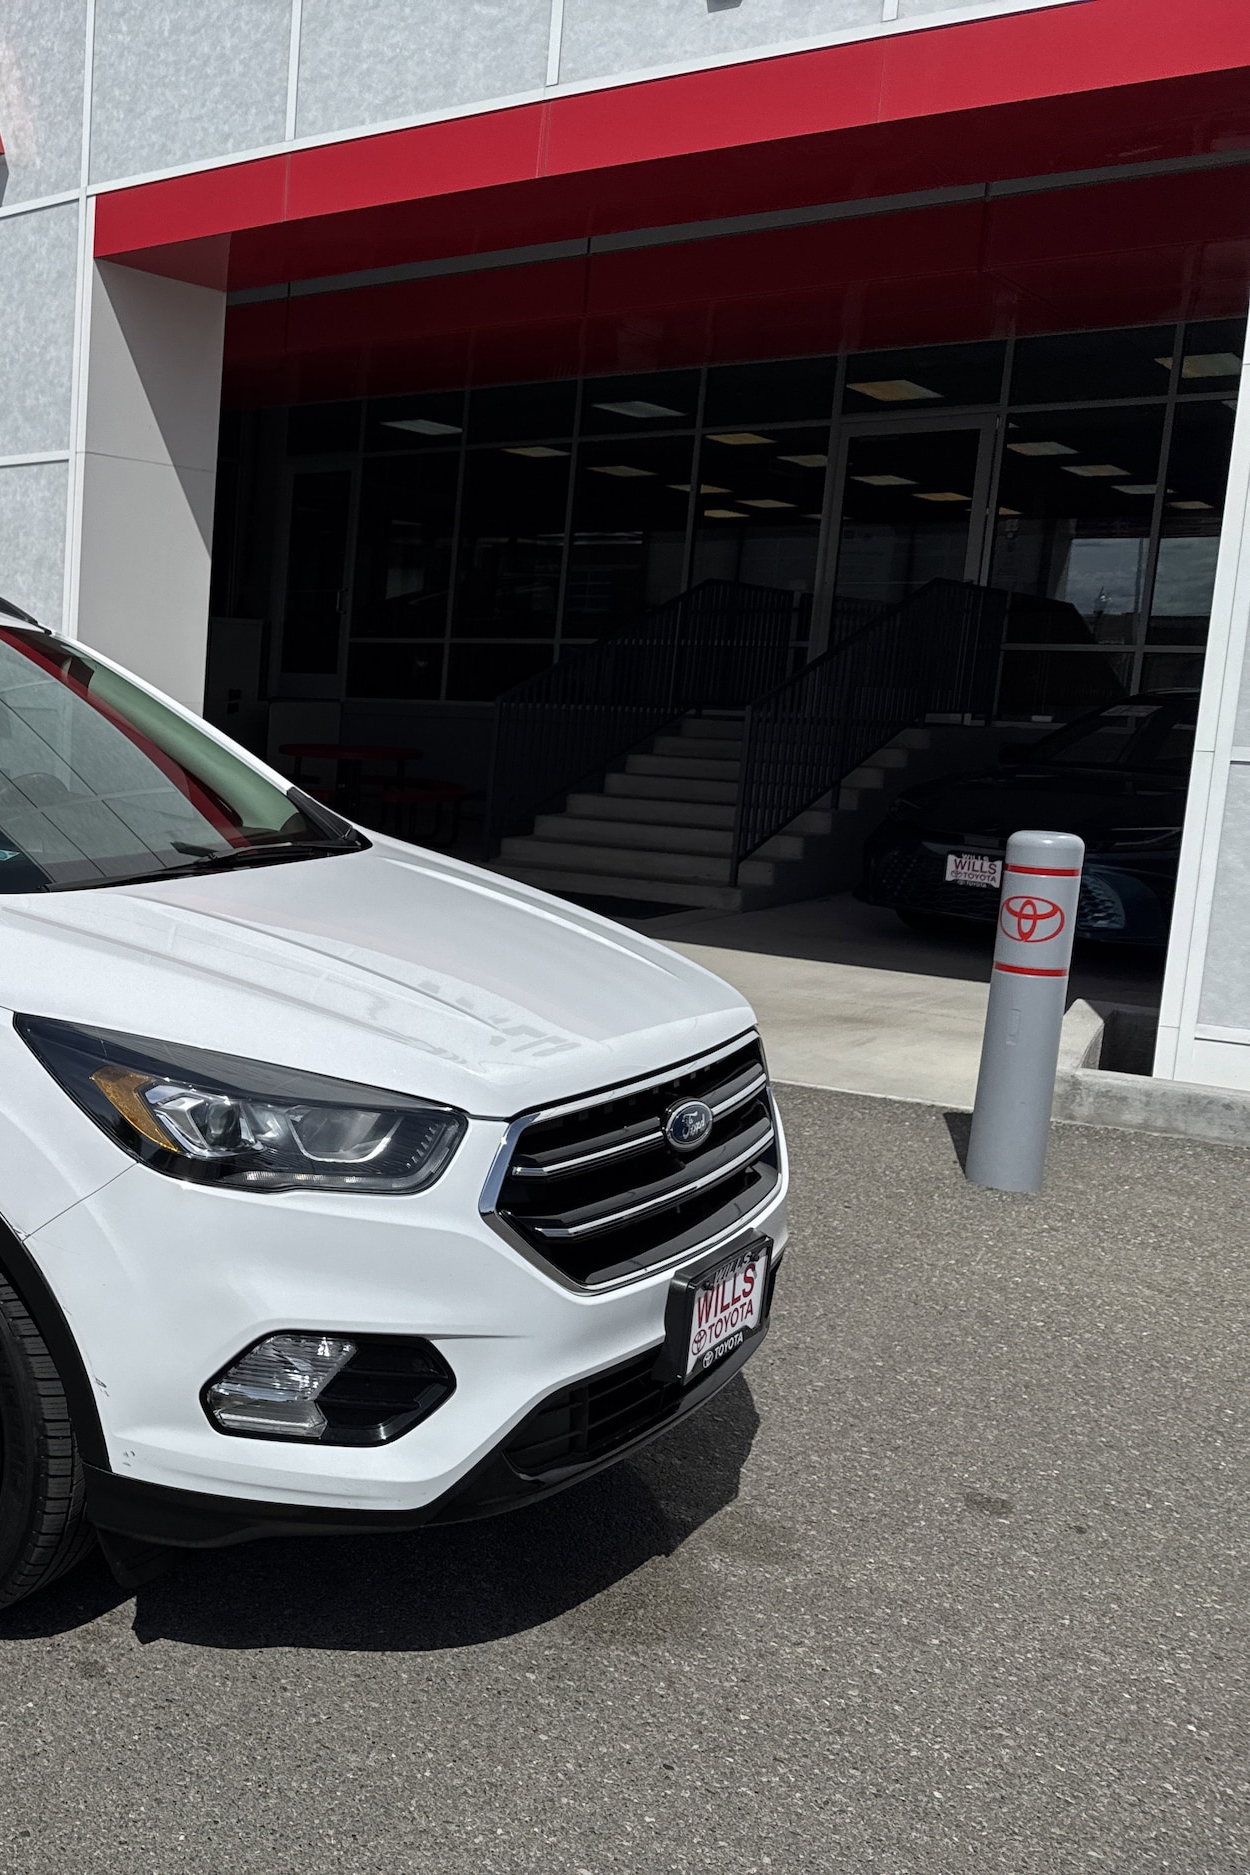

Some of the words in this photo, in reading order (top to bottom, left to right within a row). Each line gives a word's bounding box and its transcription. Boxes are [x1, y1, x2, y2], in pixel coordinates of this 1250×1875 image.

[954, 859, 997, 874] WILLS
[963, 871, 997, 883] TOYOTA
[681, 1111, 707, 1139] Ford
[714, 1251, 752, 1284] WILLS
[698, 1263, 756, 1328] WILLS
[708, 1299, 753, 1343] TOYOTA
[714, 1331, 744, 1360] TOYOTA
